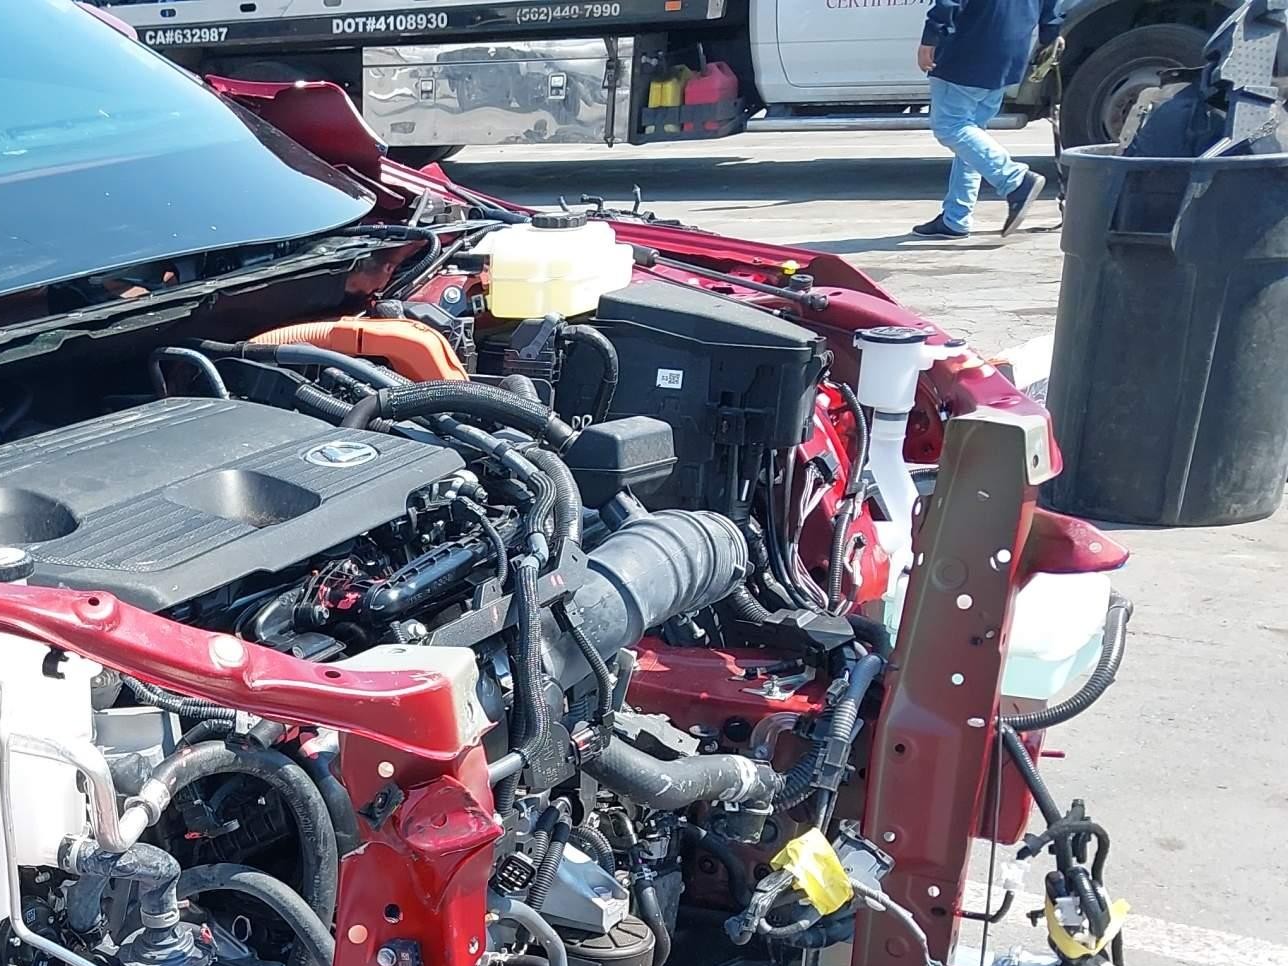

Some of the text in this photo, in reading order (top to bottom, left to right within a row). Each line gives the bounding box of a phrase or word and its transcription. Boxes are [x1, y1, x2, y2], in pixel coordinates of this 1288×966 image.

[332, 12, 448, 33] DOT#4108930
[516, 3, 620, 24] (562)440-7990
[145, 27, 228, 45] CA#632987
